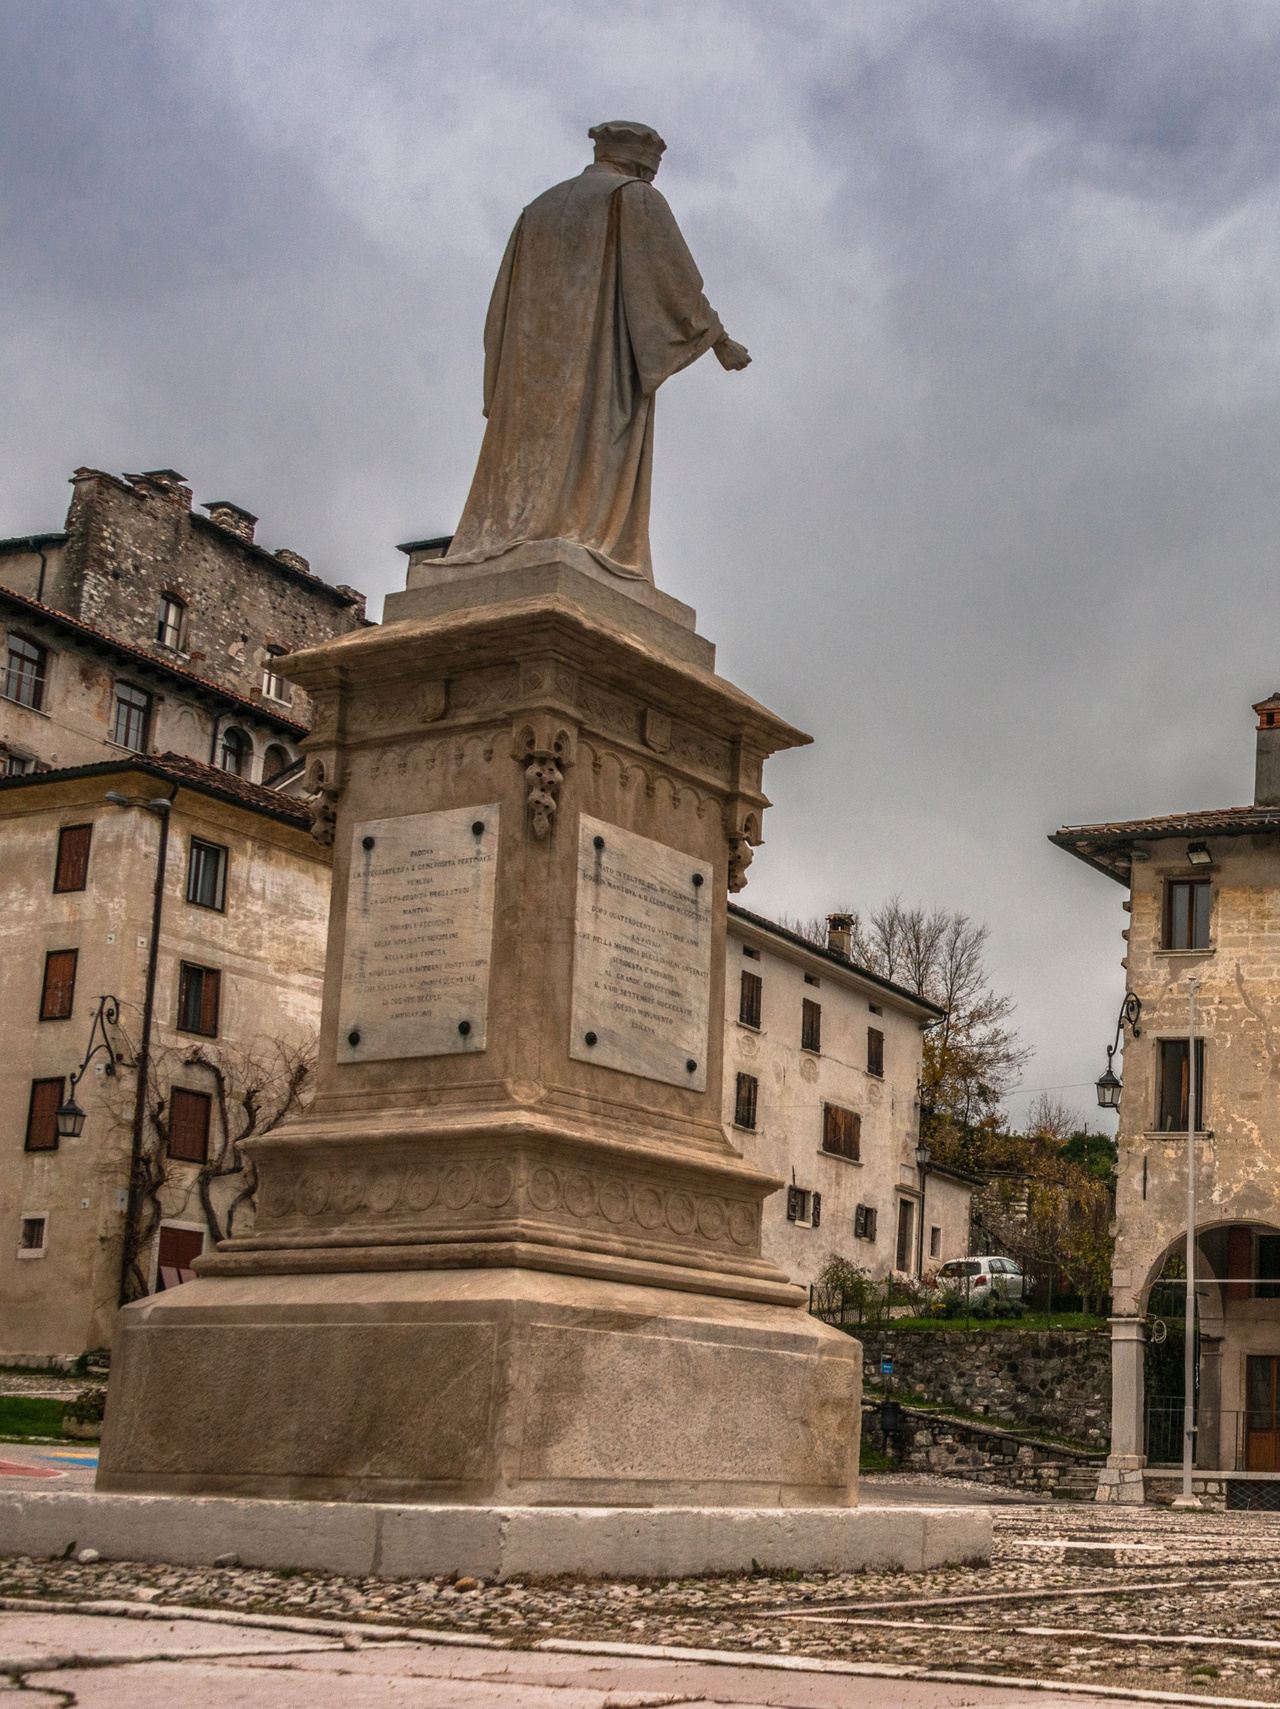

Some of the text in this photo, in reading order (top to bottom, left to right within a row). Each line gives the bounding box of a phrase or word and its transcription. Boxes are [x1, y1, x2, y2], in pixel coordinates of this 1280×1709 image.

[410, 848, 434, 857] PADOVA
[406, 877, 434, 886] VENEZIA
[607, 882, 636, 898] MANTOVA
[403, 906, 433, 915] MANTOVA
[592, 905, 607, 917] DOPO
[609, 911, 656, 933] QUATTROCENTO
[686, 938, 699, 948] ANNI
[593, 935, 612, 948] NELLA
[614, 1002, 637, 1015] QUESTO
